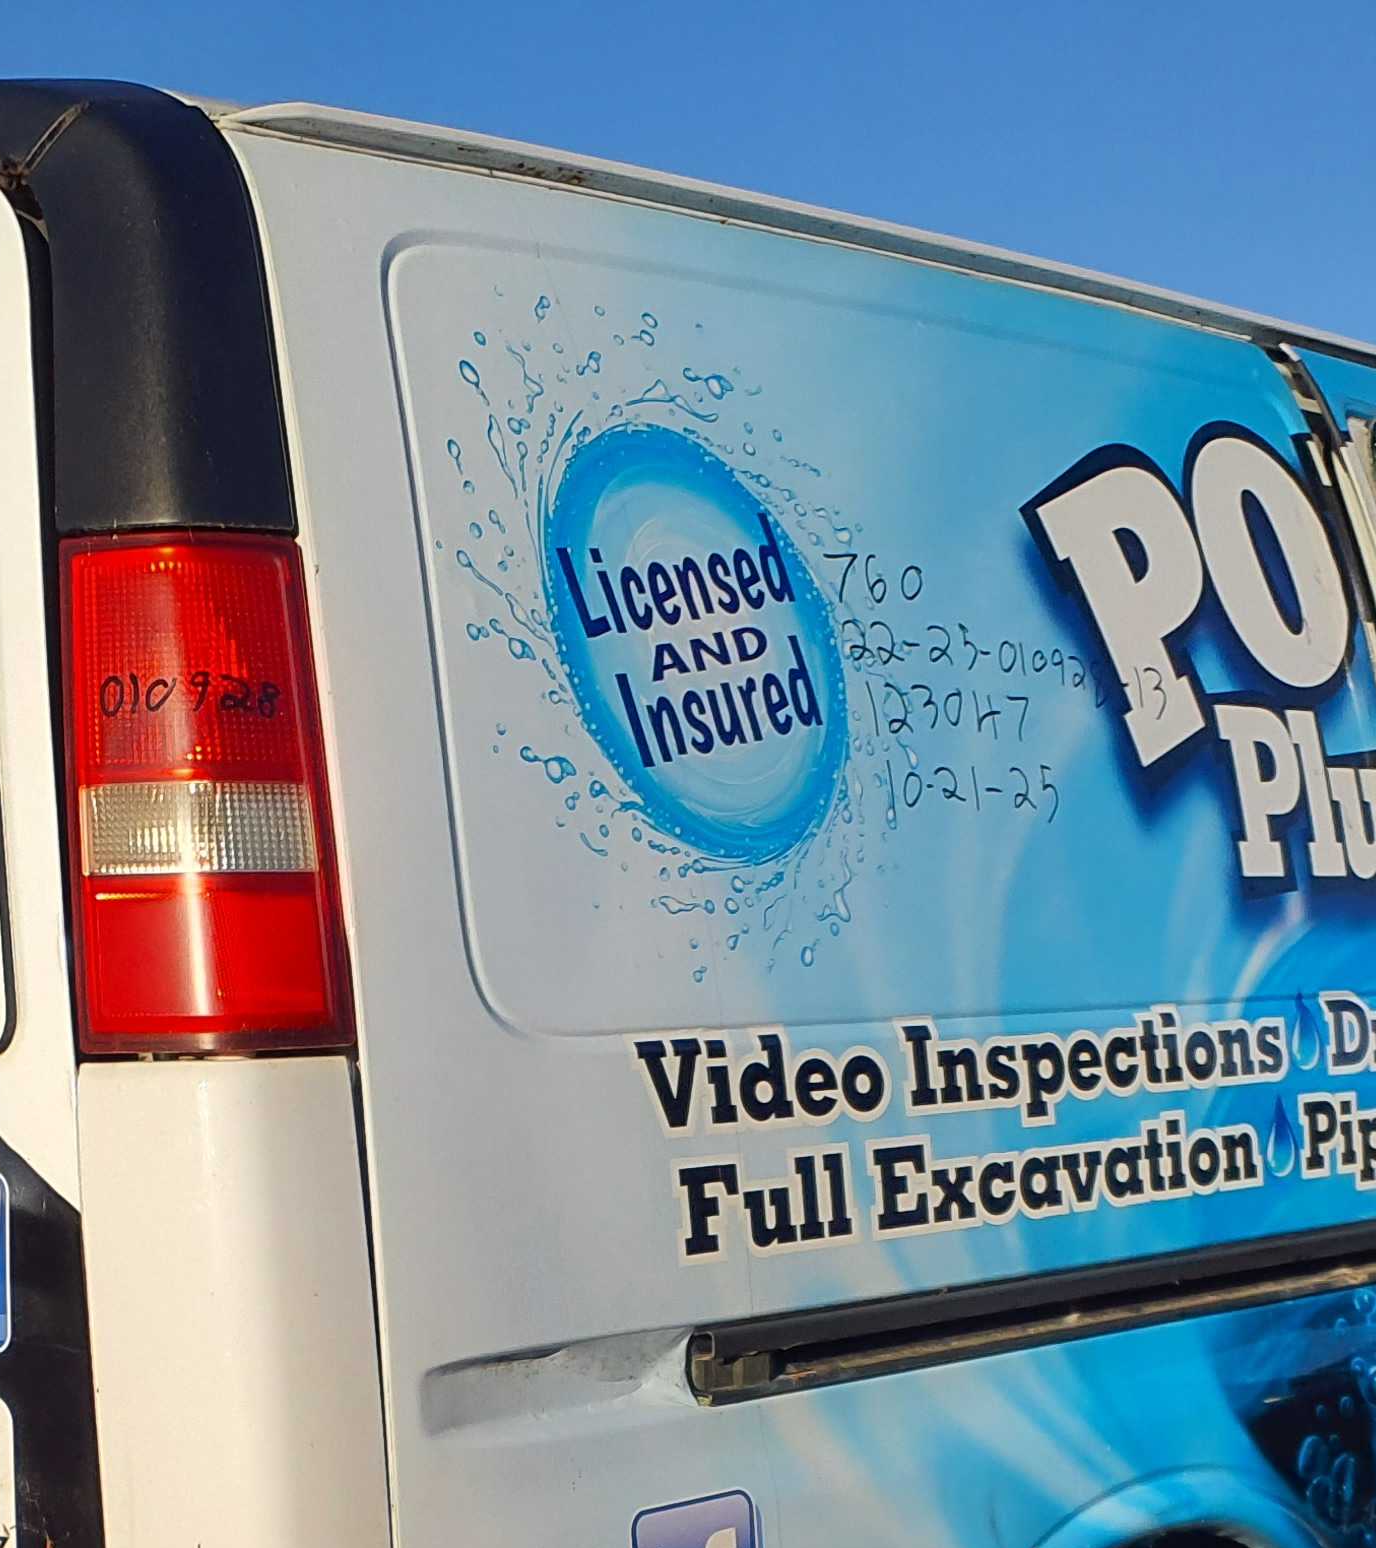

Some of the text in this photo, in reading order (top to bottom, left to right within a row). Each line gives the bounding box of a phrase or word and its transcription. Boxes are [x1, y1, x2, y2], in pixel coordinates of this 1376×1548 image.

[555, 512, 795, 639] Licensed
[823, 553, 924, 604] 760
[614, 634, 823, 768] Insured
[650, 625, 769, 682] AND
[885, 758, 1062, 824] 10-21-25
[633, 1031, 886, 1129] Video
[902, 1011, 1284, 1117] Inspections
[678, 1150, 853, 1257] Full
[872, 1117, 1258, 1231] Excavation
